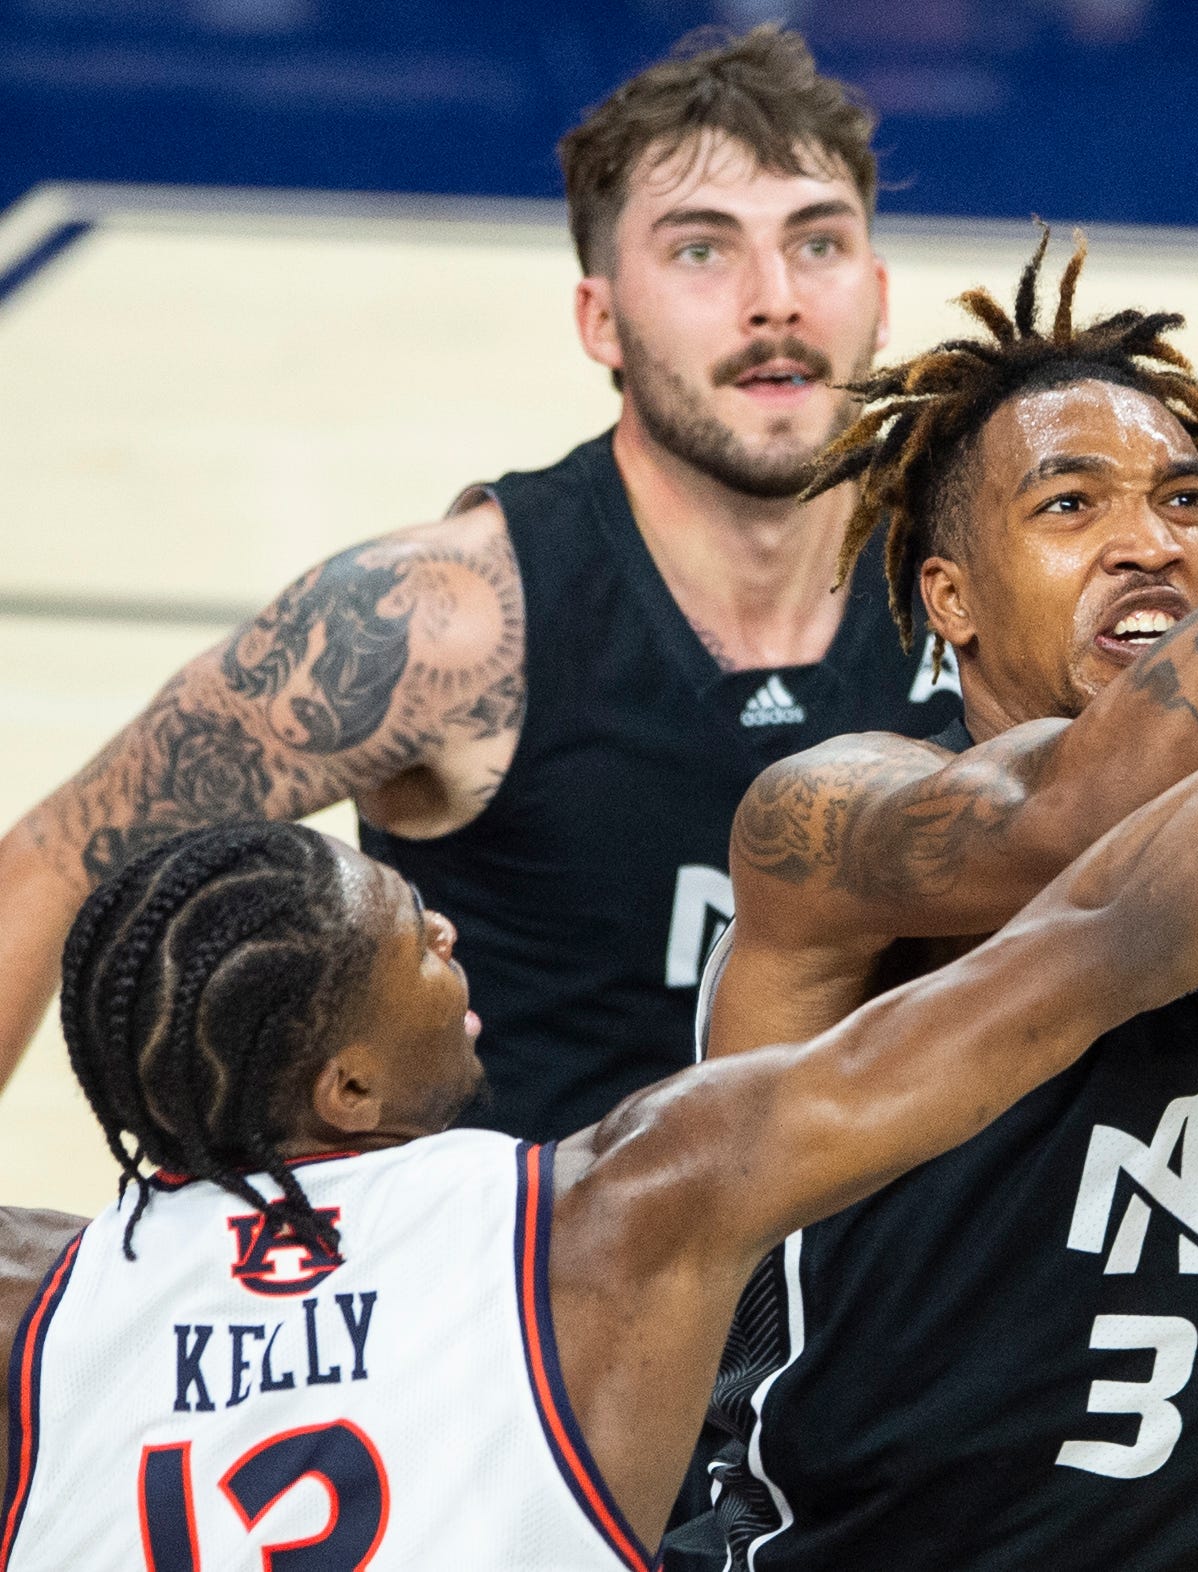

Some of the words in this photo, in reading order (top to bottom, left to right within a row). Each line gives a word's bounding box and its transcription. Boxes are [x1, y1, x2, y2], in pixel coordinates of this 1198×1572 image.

[740, 705, 805, 728] adidas
[172, 1290, 378, 1412] KELLY
[1054, 1313, 1198, 1480] 3
